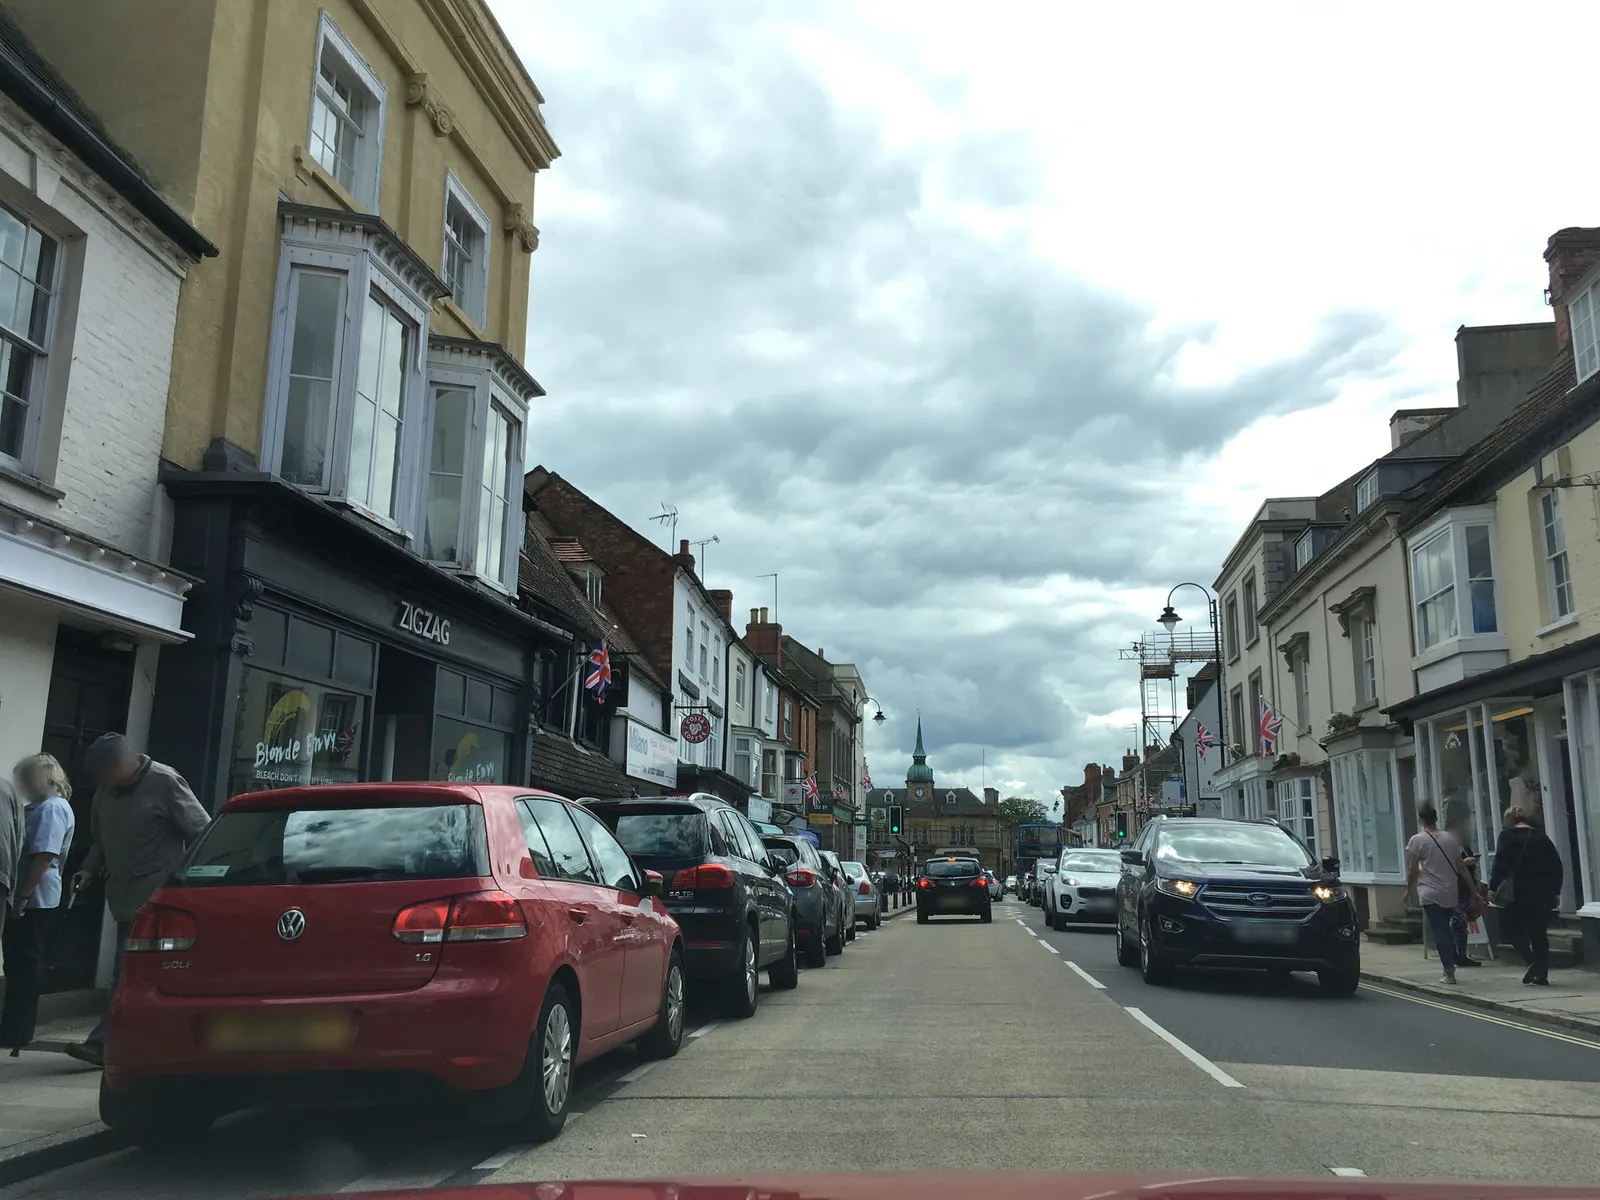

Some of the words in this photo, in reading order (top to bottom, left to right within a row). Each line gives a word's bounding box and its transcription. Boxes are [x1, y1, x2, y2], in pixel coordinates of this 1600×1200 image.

[399, 600, 451, 645] ZIGZAG
[685, 716, 705, 725] COSTA
[684, 730, 706, 741] COFFEE
[253, 738, 301, 768] Blonde
[306, 730, 336, 756] Envy
[256, 770, 279, 781] BLEACH
[415, 952, 431, 962] 1.6
[162, 960, 193, 970] GOLF
